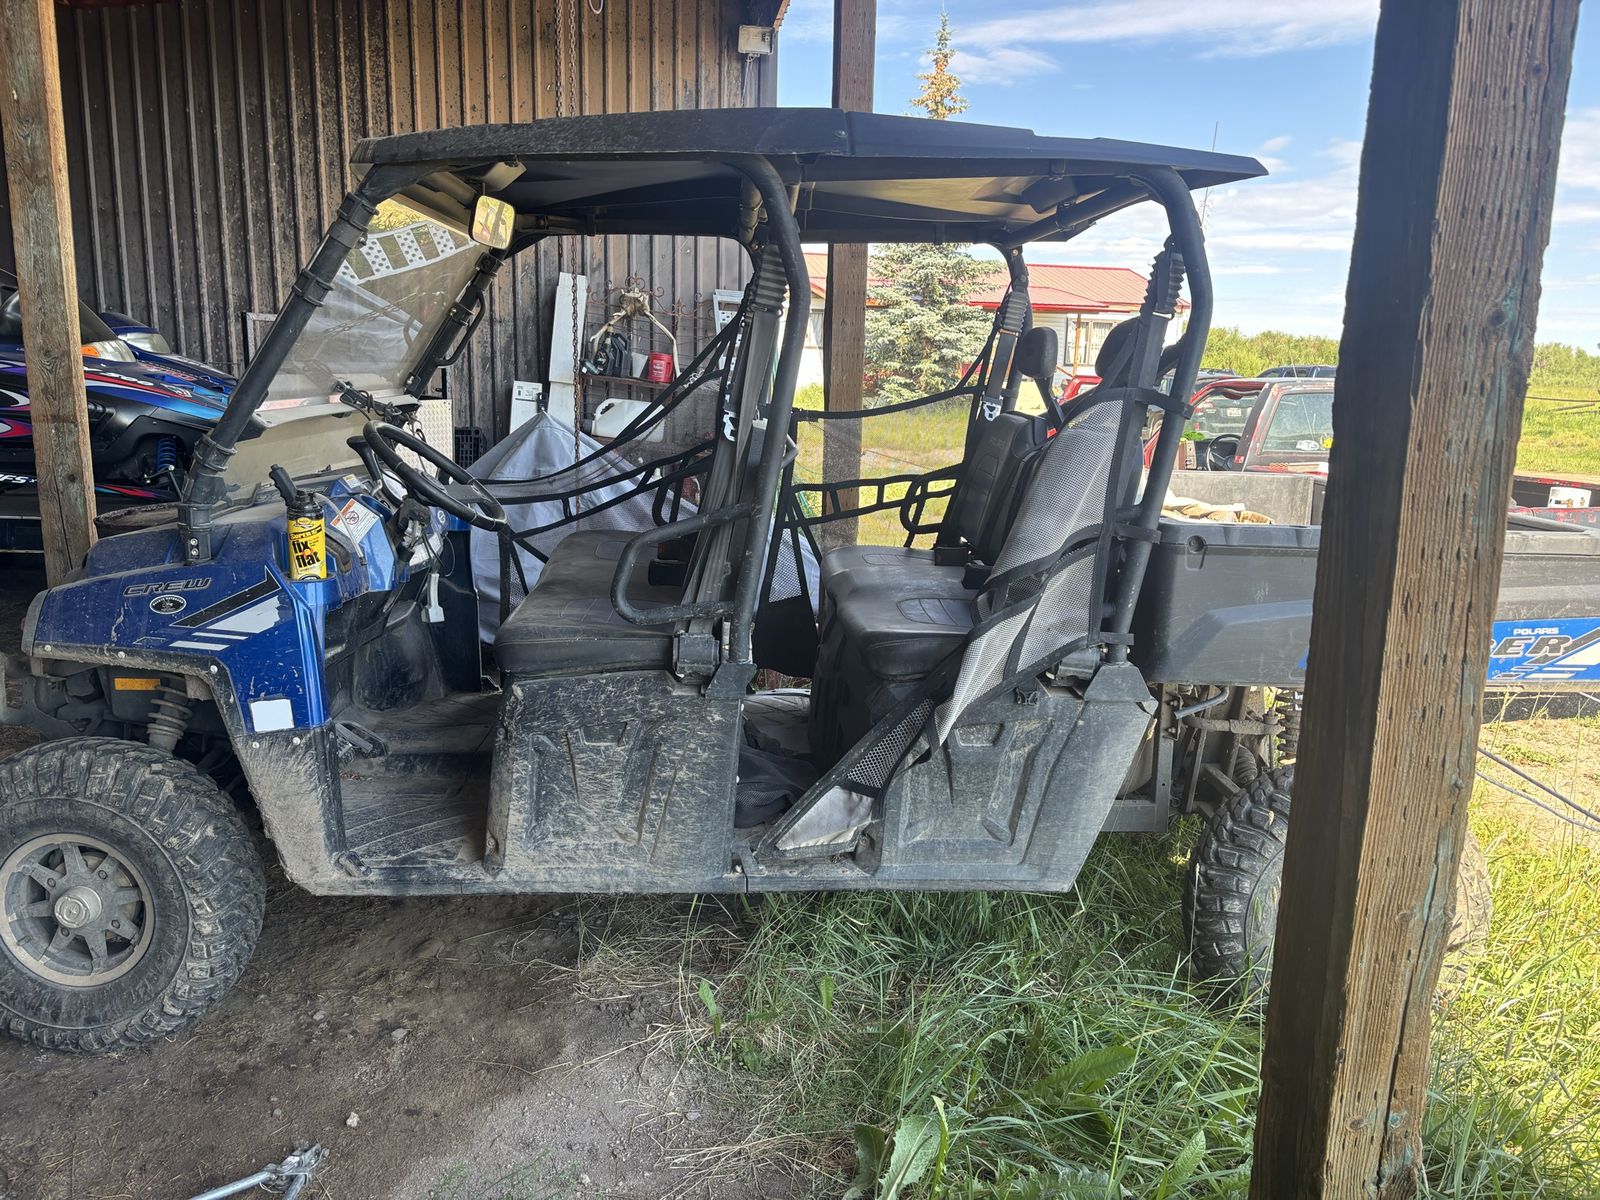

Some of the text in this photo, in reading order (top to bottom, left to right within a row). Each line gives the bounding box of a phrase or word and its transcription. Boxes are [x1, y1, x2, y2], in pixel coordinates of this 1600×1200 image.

[292, 540, 309, 553] fix
[296, 551, 321, 568] flat
[123, 577, 212, 597] CREW
[1513, 627, 1559, 635] POLARIS
[1490, 635, 1573, 657] ER
